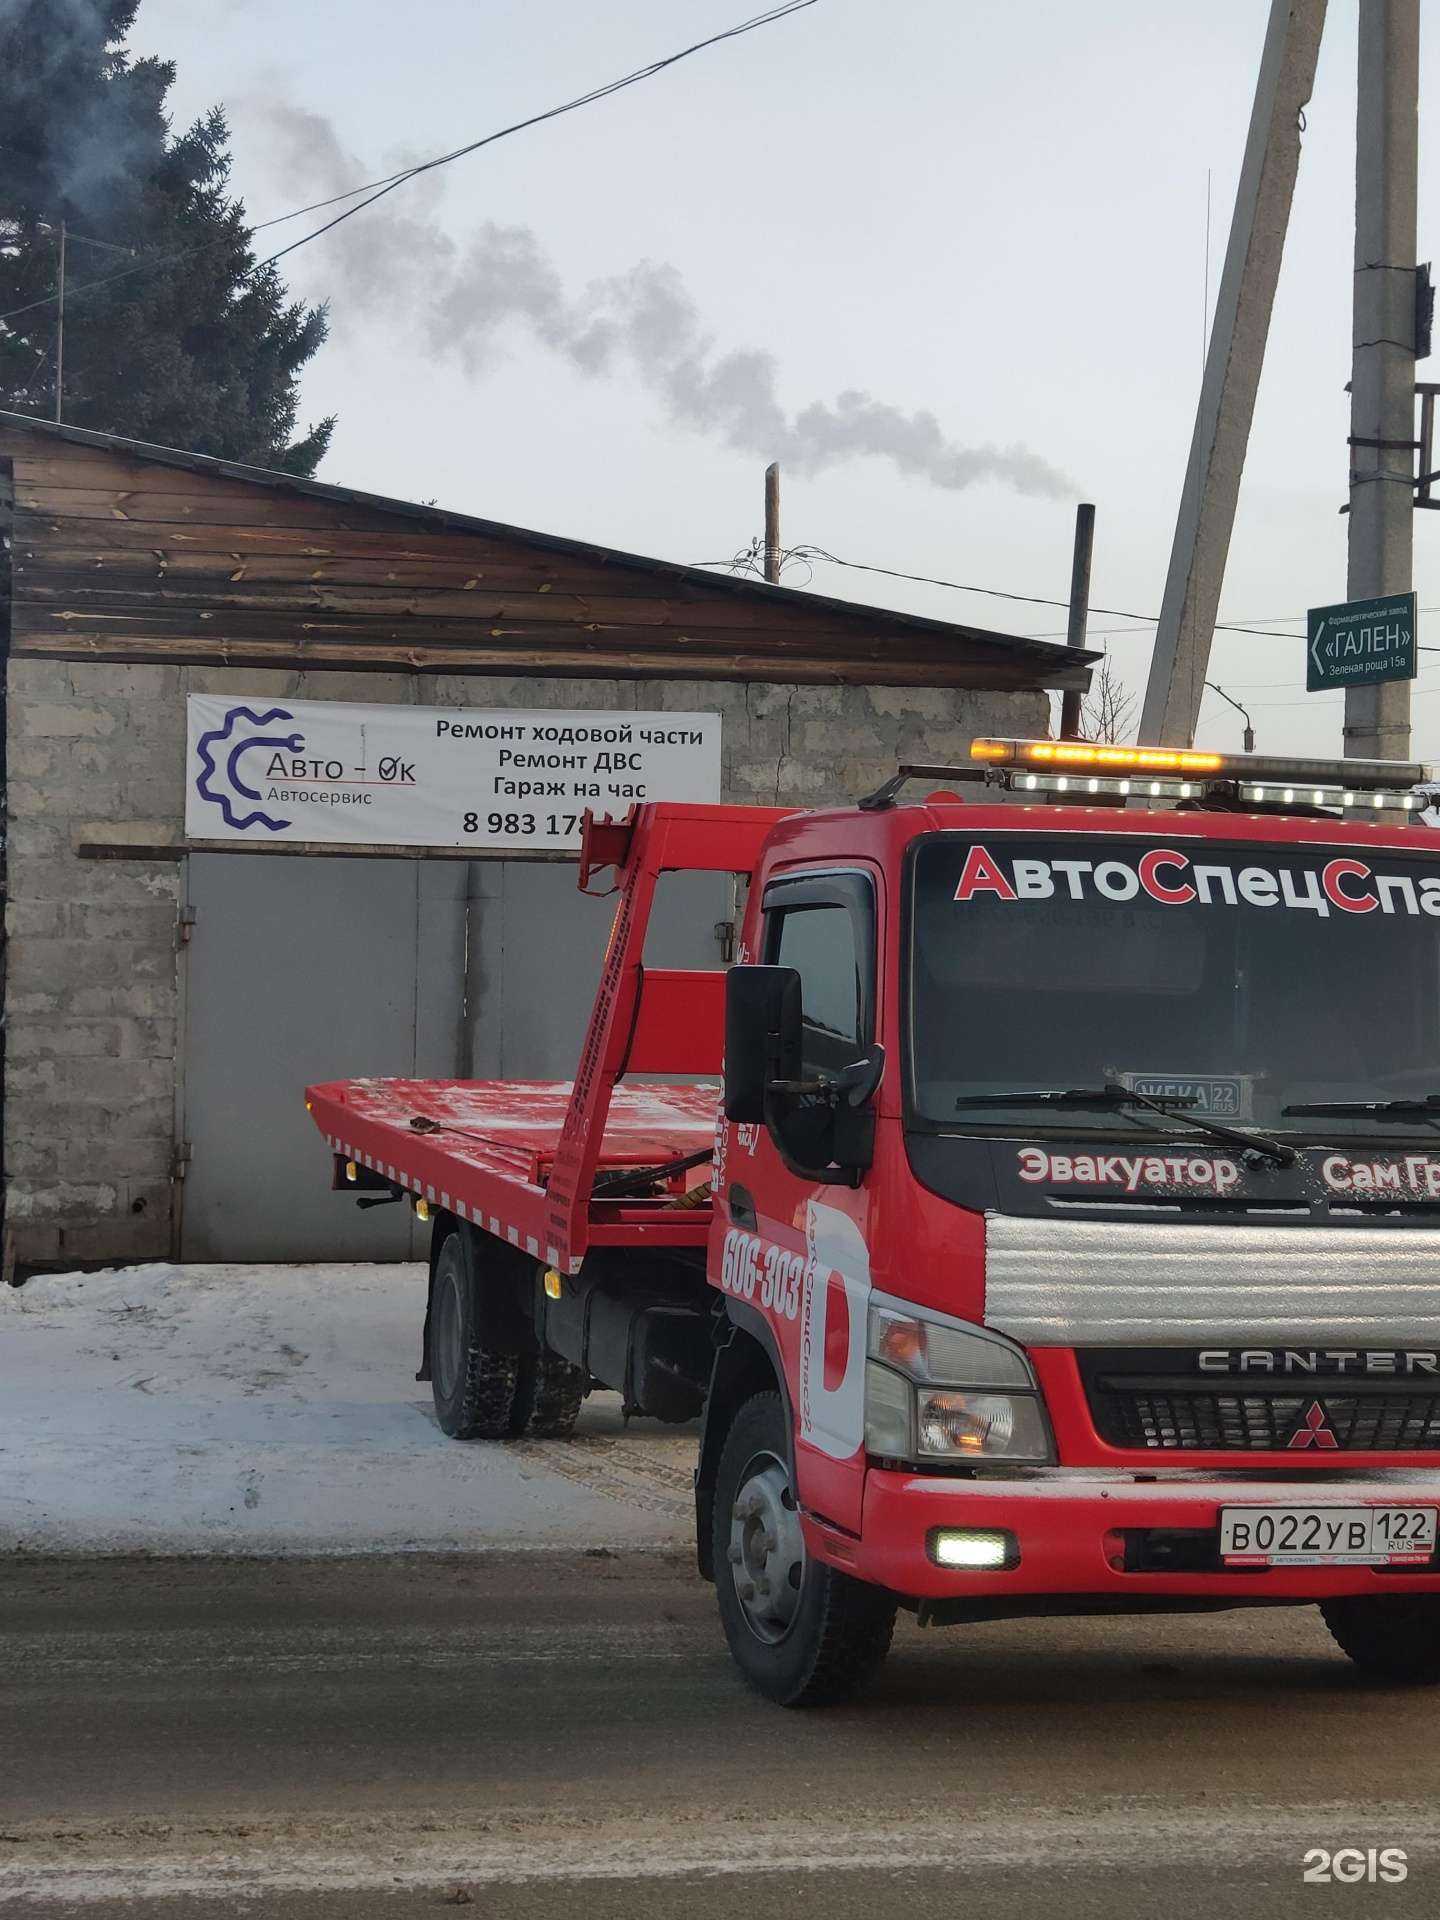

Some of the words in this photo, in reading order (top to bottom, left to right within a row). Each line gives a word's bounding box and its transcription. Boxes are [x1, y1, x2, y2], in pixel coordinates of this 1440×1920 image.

[1325, 624, 1411, 657] «ГАЛЕН»
[1330, 663, 1364, 676] Зеленая
[1365, 660, 1388, 674] роща
[1391, 656, 1406, 667] 15в
[435, 720, 526, 741] Ремонт
[532, 722, 633, 747] ходовой
[639, 727, 703, 747] части
[266, 752, 345, 780] Авто
[499, 749, 588, 773] Ремонт
[593, 751, 642, 773] ДВС
[266, 787, 373, 806] Автосервис
[494, 777, 566, 800] Гараж
[572, 781, 600, 798] на
[605, 782, 646, 799] час
[463, 813, 478, 832] 8
[488, 813, 536, 834] 983
[1213, 1087, 1232, 1102] 22
[1213, 1103, 1234, 1111] RUS
[1017, 1147, 1239, 1193] Эвакуатор
[721, 1229, 804, 1321] 606-303
[1199, 1351, 1440, 1374] CANTER
[1231, 1514, 1366, 1551] В022УВ
[1377, 1512, 1427, 1539] 122
[1388, 1540, 1413, 1551] RUS
